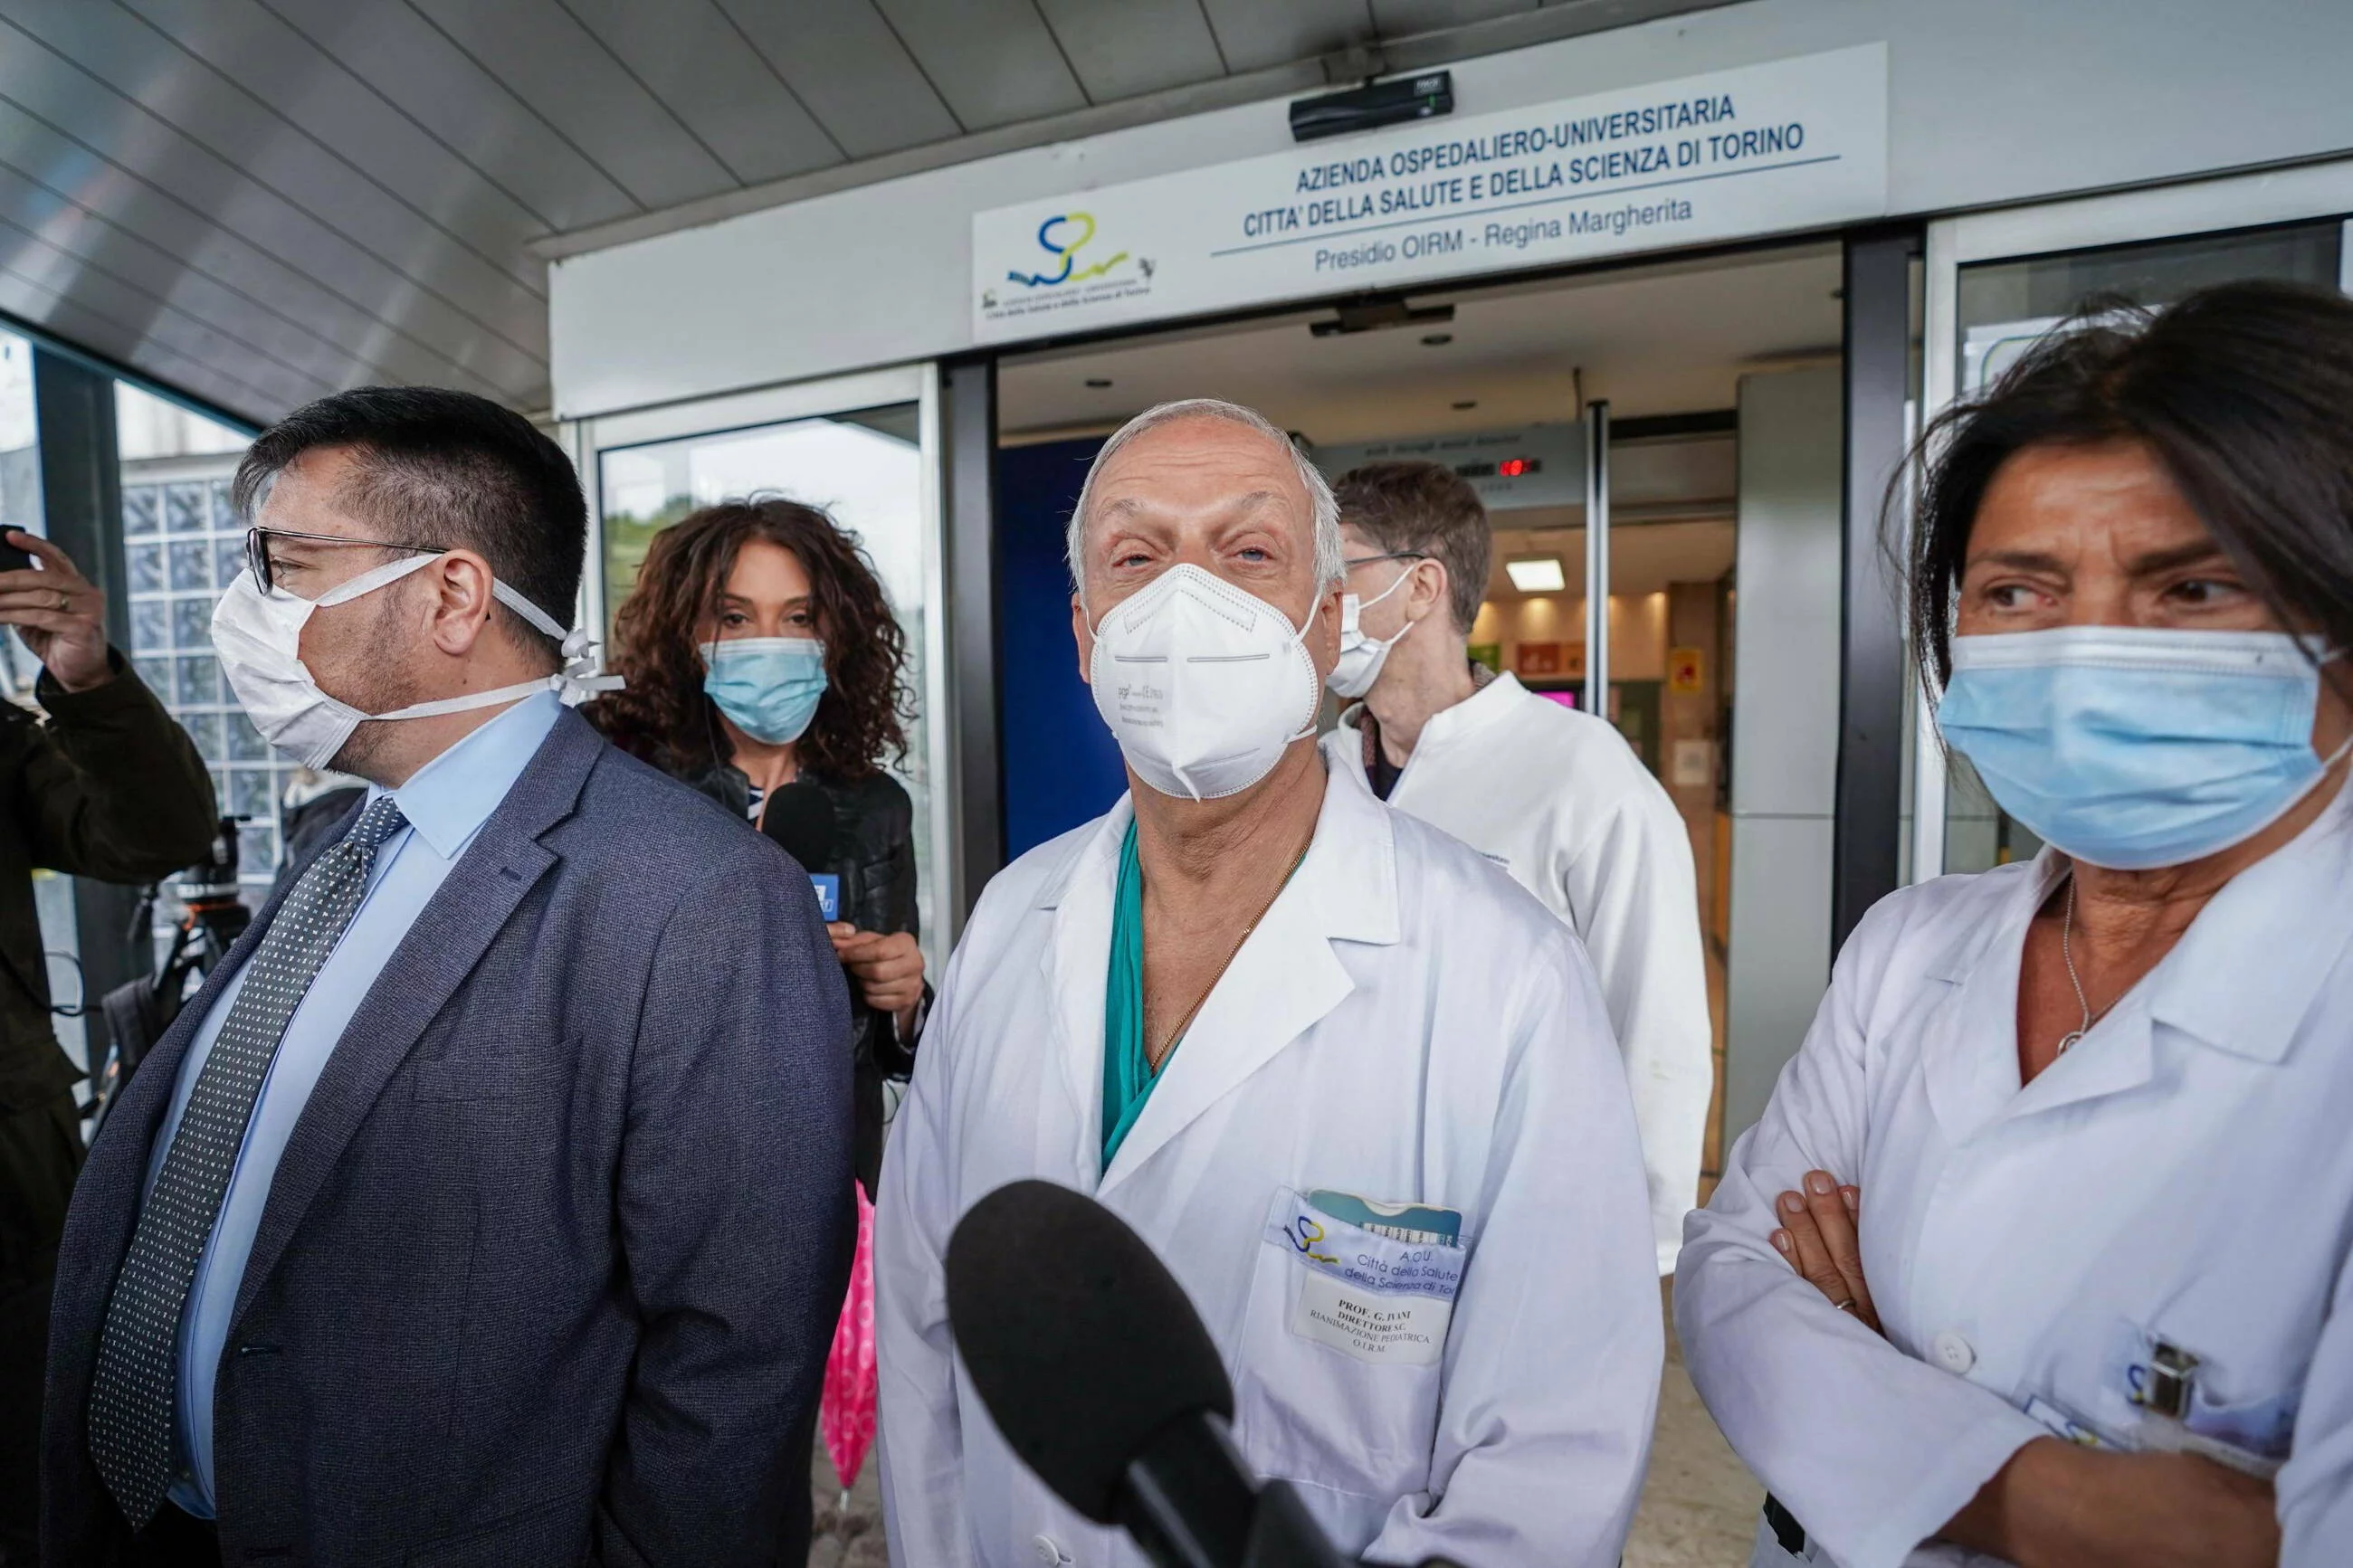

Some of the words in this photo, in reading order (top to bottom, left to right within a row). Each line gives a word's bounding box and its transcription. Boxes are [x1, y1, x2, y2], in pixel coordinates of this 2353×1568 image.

[1296, 156, 1385, 194] AZIENDA
[1390, 93, 1736, 176] OSPEDALIERO-UNIVERSITARIA
[1243, 204, 1303, 237] CITTA'
[1308, 194, 1375, 226] DELLA
[1380, 178, 1462, 214] SALUTE
[1471, 175, 1483, 200] E
[1491, 162, 1564, 197] DELLA
[1569, 145, 1671, 184] SCIENZA
[1678, 139, 1700, 167] DI
[1708, 123, 1804, 162] TORINO
[1315, 240, 1396, 271] Presidio
[1402, 229, 1463, 260] OIRM
[1484, 217, 1561, 249] Regina
[1569, 198, 1693, 235] Margherita
[1345, 1268, 1376, 1286] della
[1423, 1281, 1435, 1291] di
[1358, 1254, 1388, 1273] Città
[1391, 1267, 1419, 1278] della
[1421, 1266, 1459, 1281] Salute
[1338, 1299, 1370, 1318] PROF.
[1374, 1312, 1385, 1322] G.
[1338, 1311, 1394, 1333] DIRETTORE
[1310, 1309, 1378, 1342] RIANIMAZIONE
[1381, 1333, 1431, 1344] PEDIATRICA
